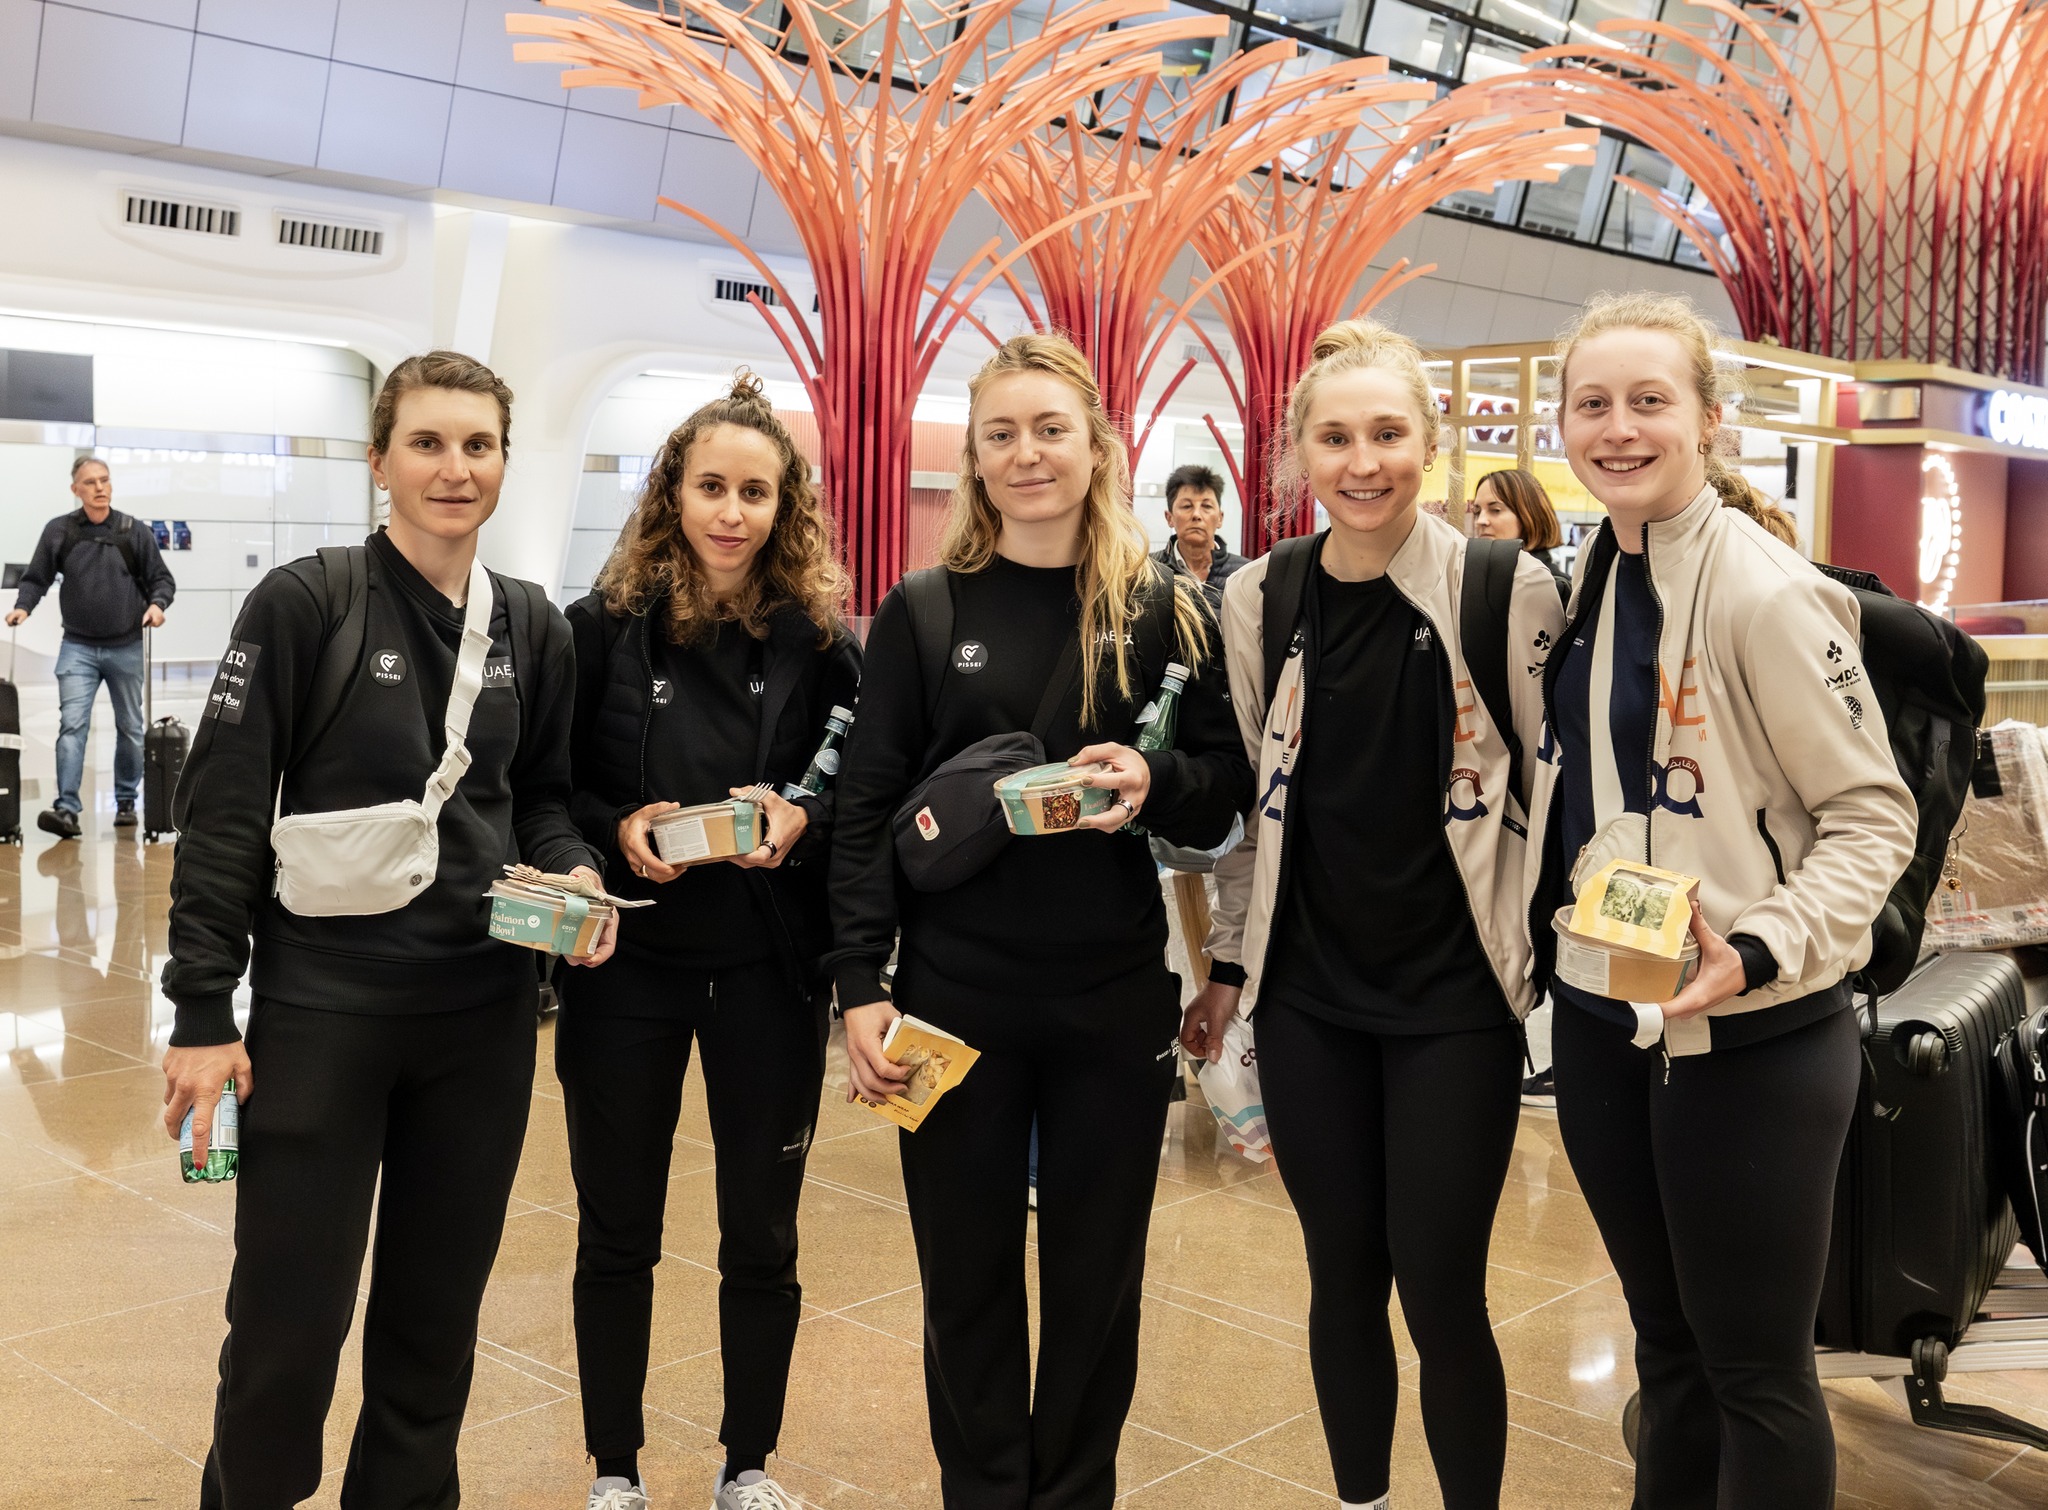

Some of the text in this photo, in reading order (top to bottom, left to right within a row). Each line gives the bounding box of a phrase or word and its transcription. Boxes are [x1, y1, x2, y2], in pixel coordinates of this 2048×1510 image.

[1415, 627, 1432, 641] UA
[376, 672, 401, 681] PISSEI
[483, 664, 512, 678] UAE
[494, 911, 525, 926] Salmon
[496, 924, 515, 937] Bowl
